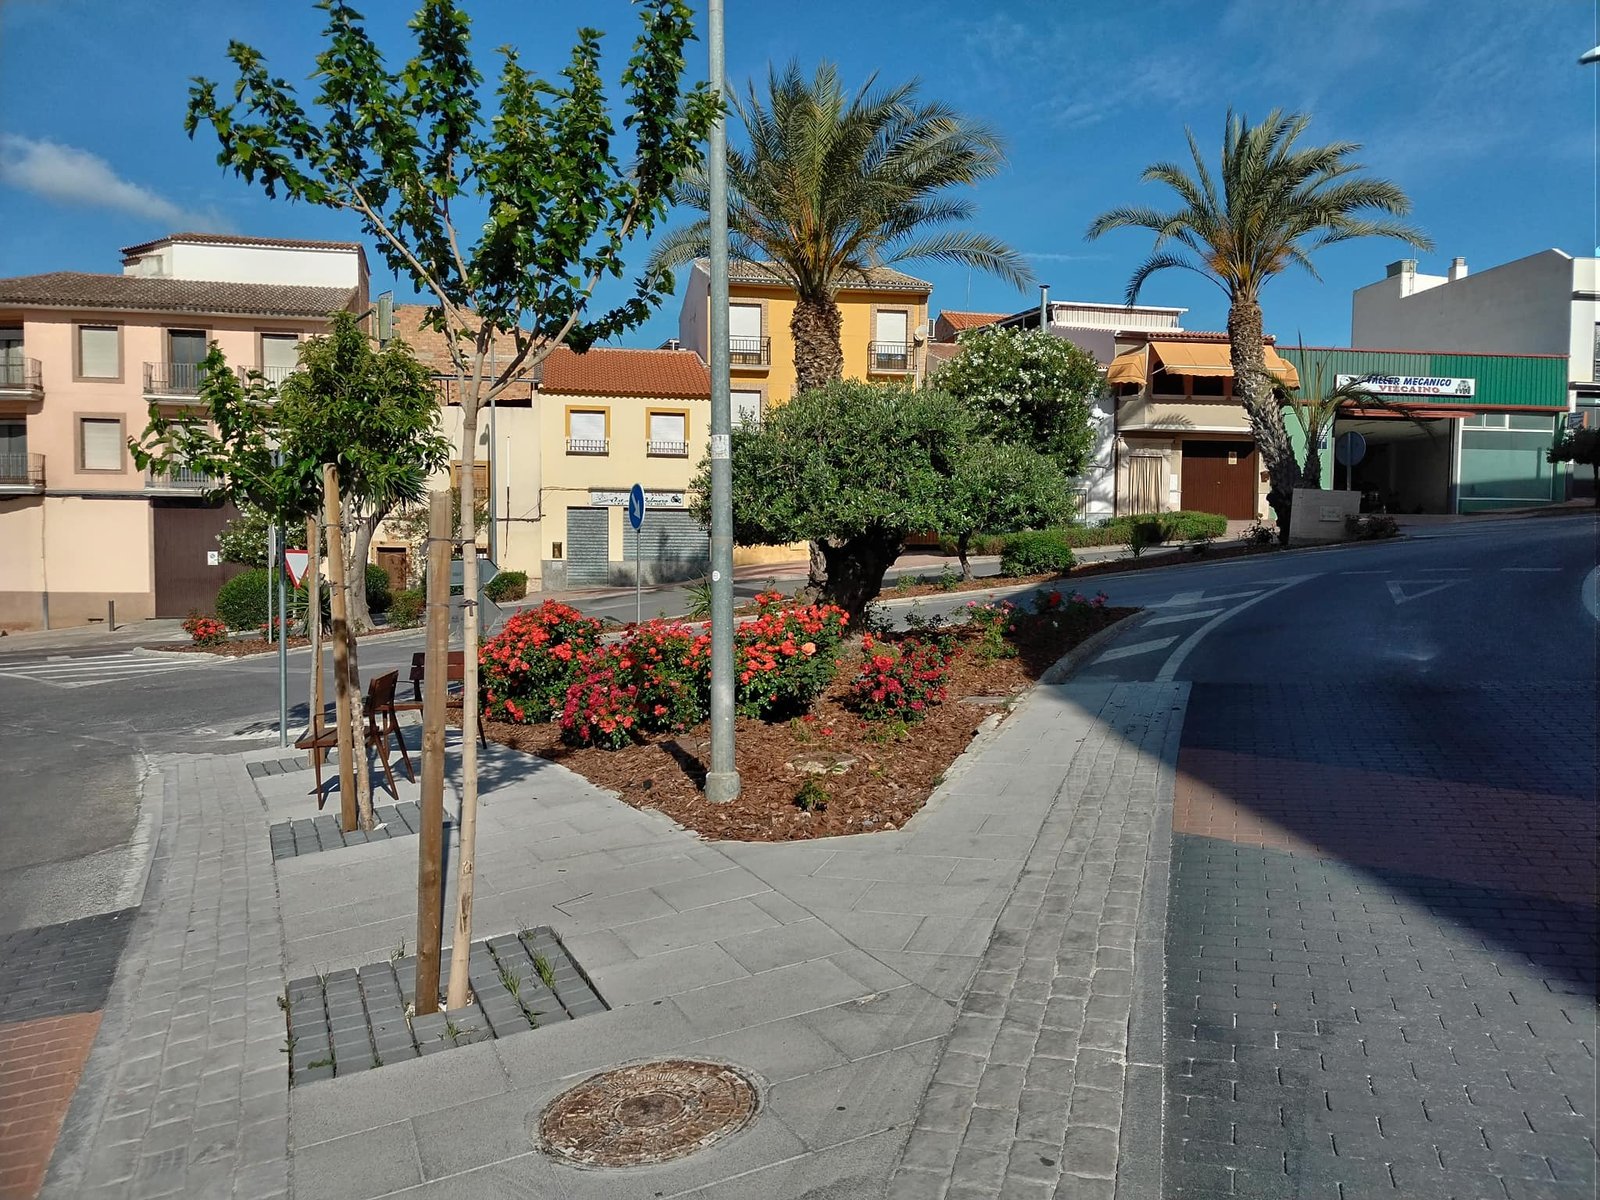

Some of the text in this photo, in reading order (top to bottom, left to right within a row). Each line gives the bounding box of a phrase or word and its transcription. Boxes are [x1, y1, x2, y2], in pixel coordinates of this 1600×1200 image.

[1367, 374, 1452, 387] TALLER MECANICO
[1379, 385, 1441, 394] VIZCAINO
